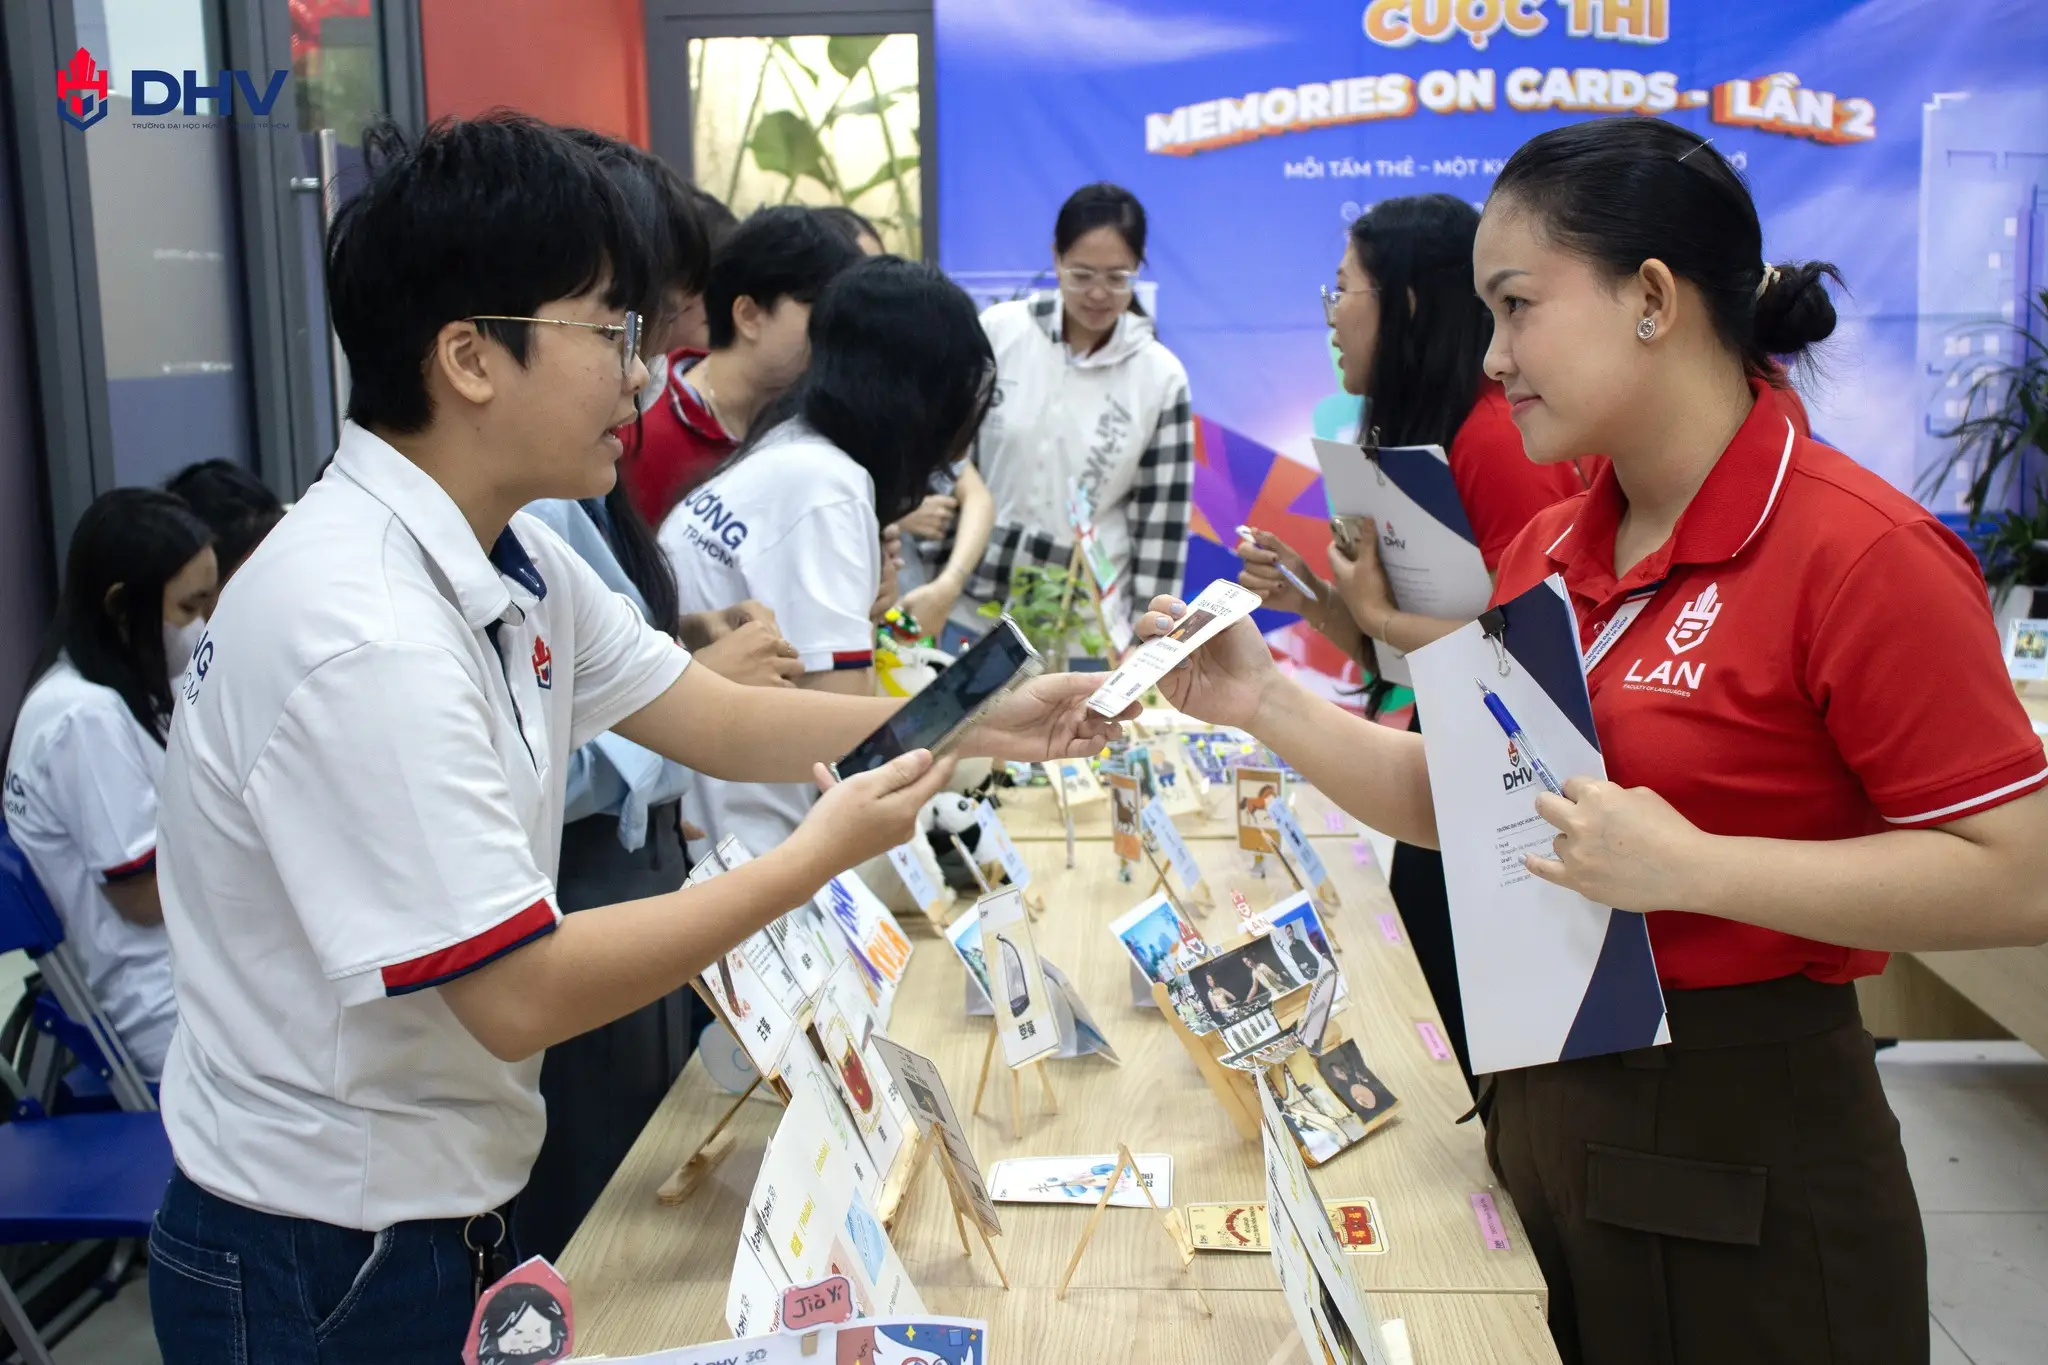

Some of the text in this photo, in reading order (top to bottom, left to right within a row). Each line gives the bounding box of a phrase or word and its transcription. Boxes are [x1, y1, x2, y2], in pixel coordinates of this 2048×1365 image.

[1557, 0, 1670, 44] THI
[1145, 73, 1416, 156] MEMORIES
[1417, 68, 1496, 115] ON
[1505, 67, 1678, 115] CARDS
[1722, 71, 1838, 134] LẦN
[1844, 97, 1876, 142] 2
[1623, 658, 1707, 690] LAN
[1503, 766, 1533, 791] DHV
